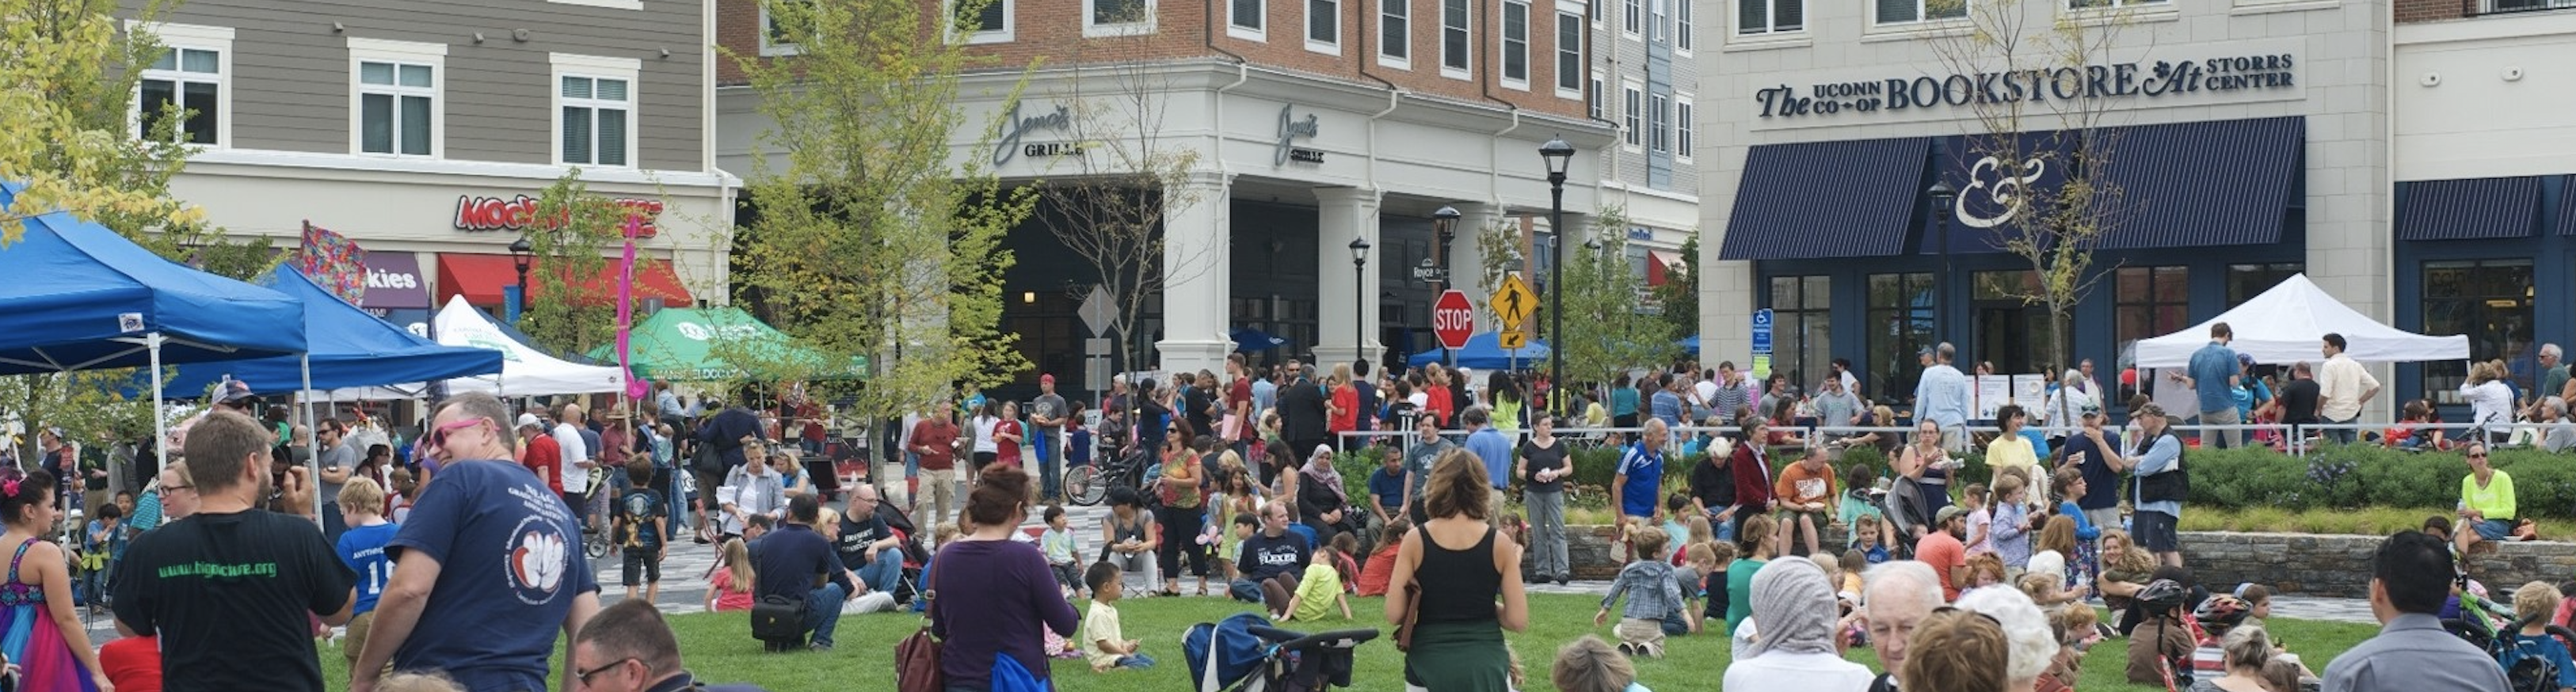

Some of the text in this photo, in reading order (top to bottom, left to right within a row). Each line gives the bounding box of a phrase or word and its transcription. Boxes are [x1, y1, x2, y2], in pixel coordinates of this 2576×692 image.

[2206, 53, 2293, 74] STORRS
[1884, 62, 2140, 110] BOOKSTORE
[2143, 60, 2203, 97] At
[2205, 71, 2294, 91] CENTER
[1755, 84, 1812, 118] The
[1812, 81, 1881, 99] UCONN
[1413, 266, 1435, 280] Royce
[1435, 308, 1473, 331] STOP
